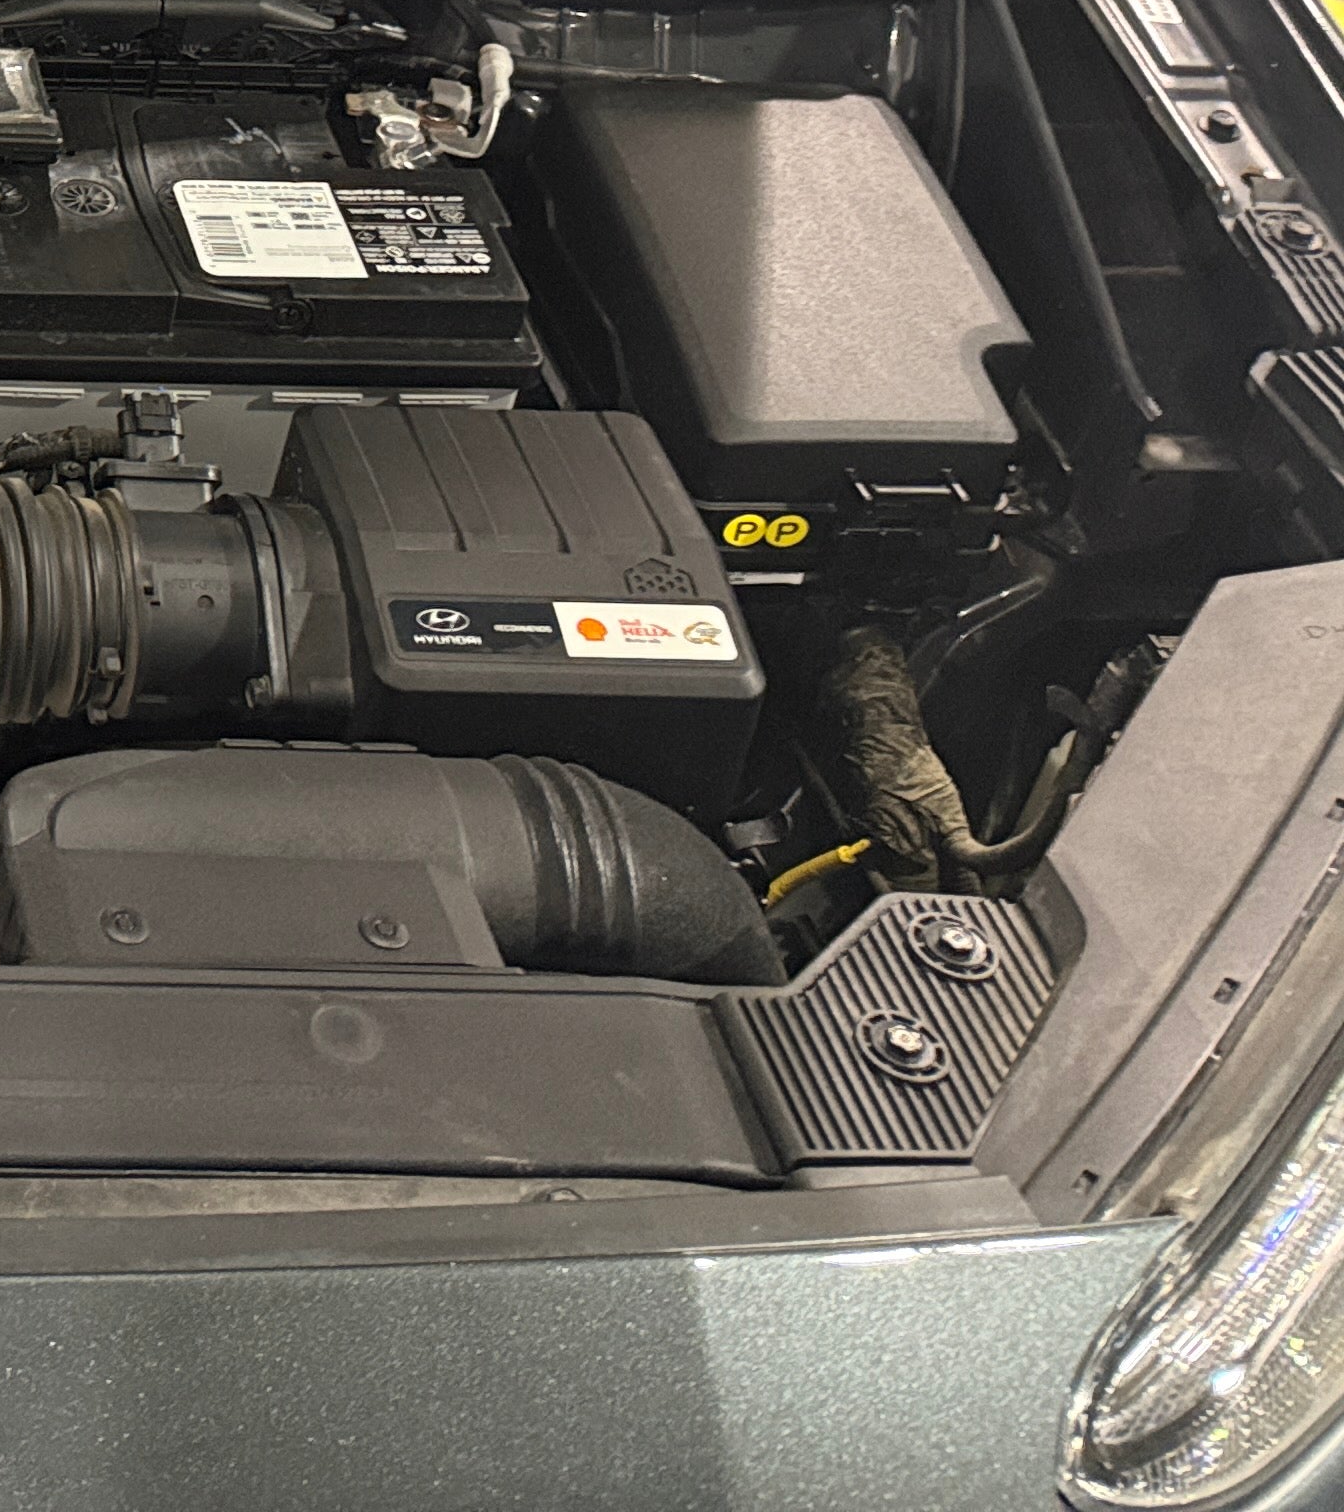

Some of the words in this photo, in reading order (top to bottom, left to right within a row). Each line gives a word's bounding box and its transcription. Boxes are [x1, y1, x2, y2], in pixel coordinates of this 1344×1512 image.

[733, 522, 758, 541] P
[774, 522, 800, 542] P
[621, 627, 676, 637] HELIX
[413, 634, 482, 645] HYUNDAI
